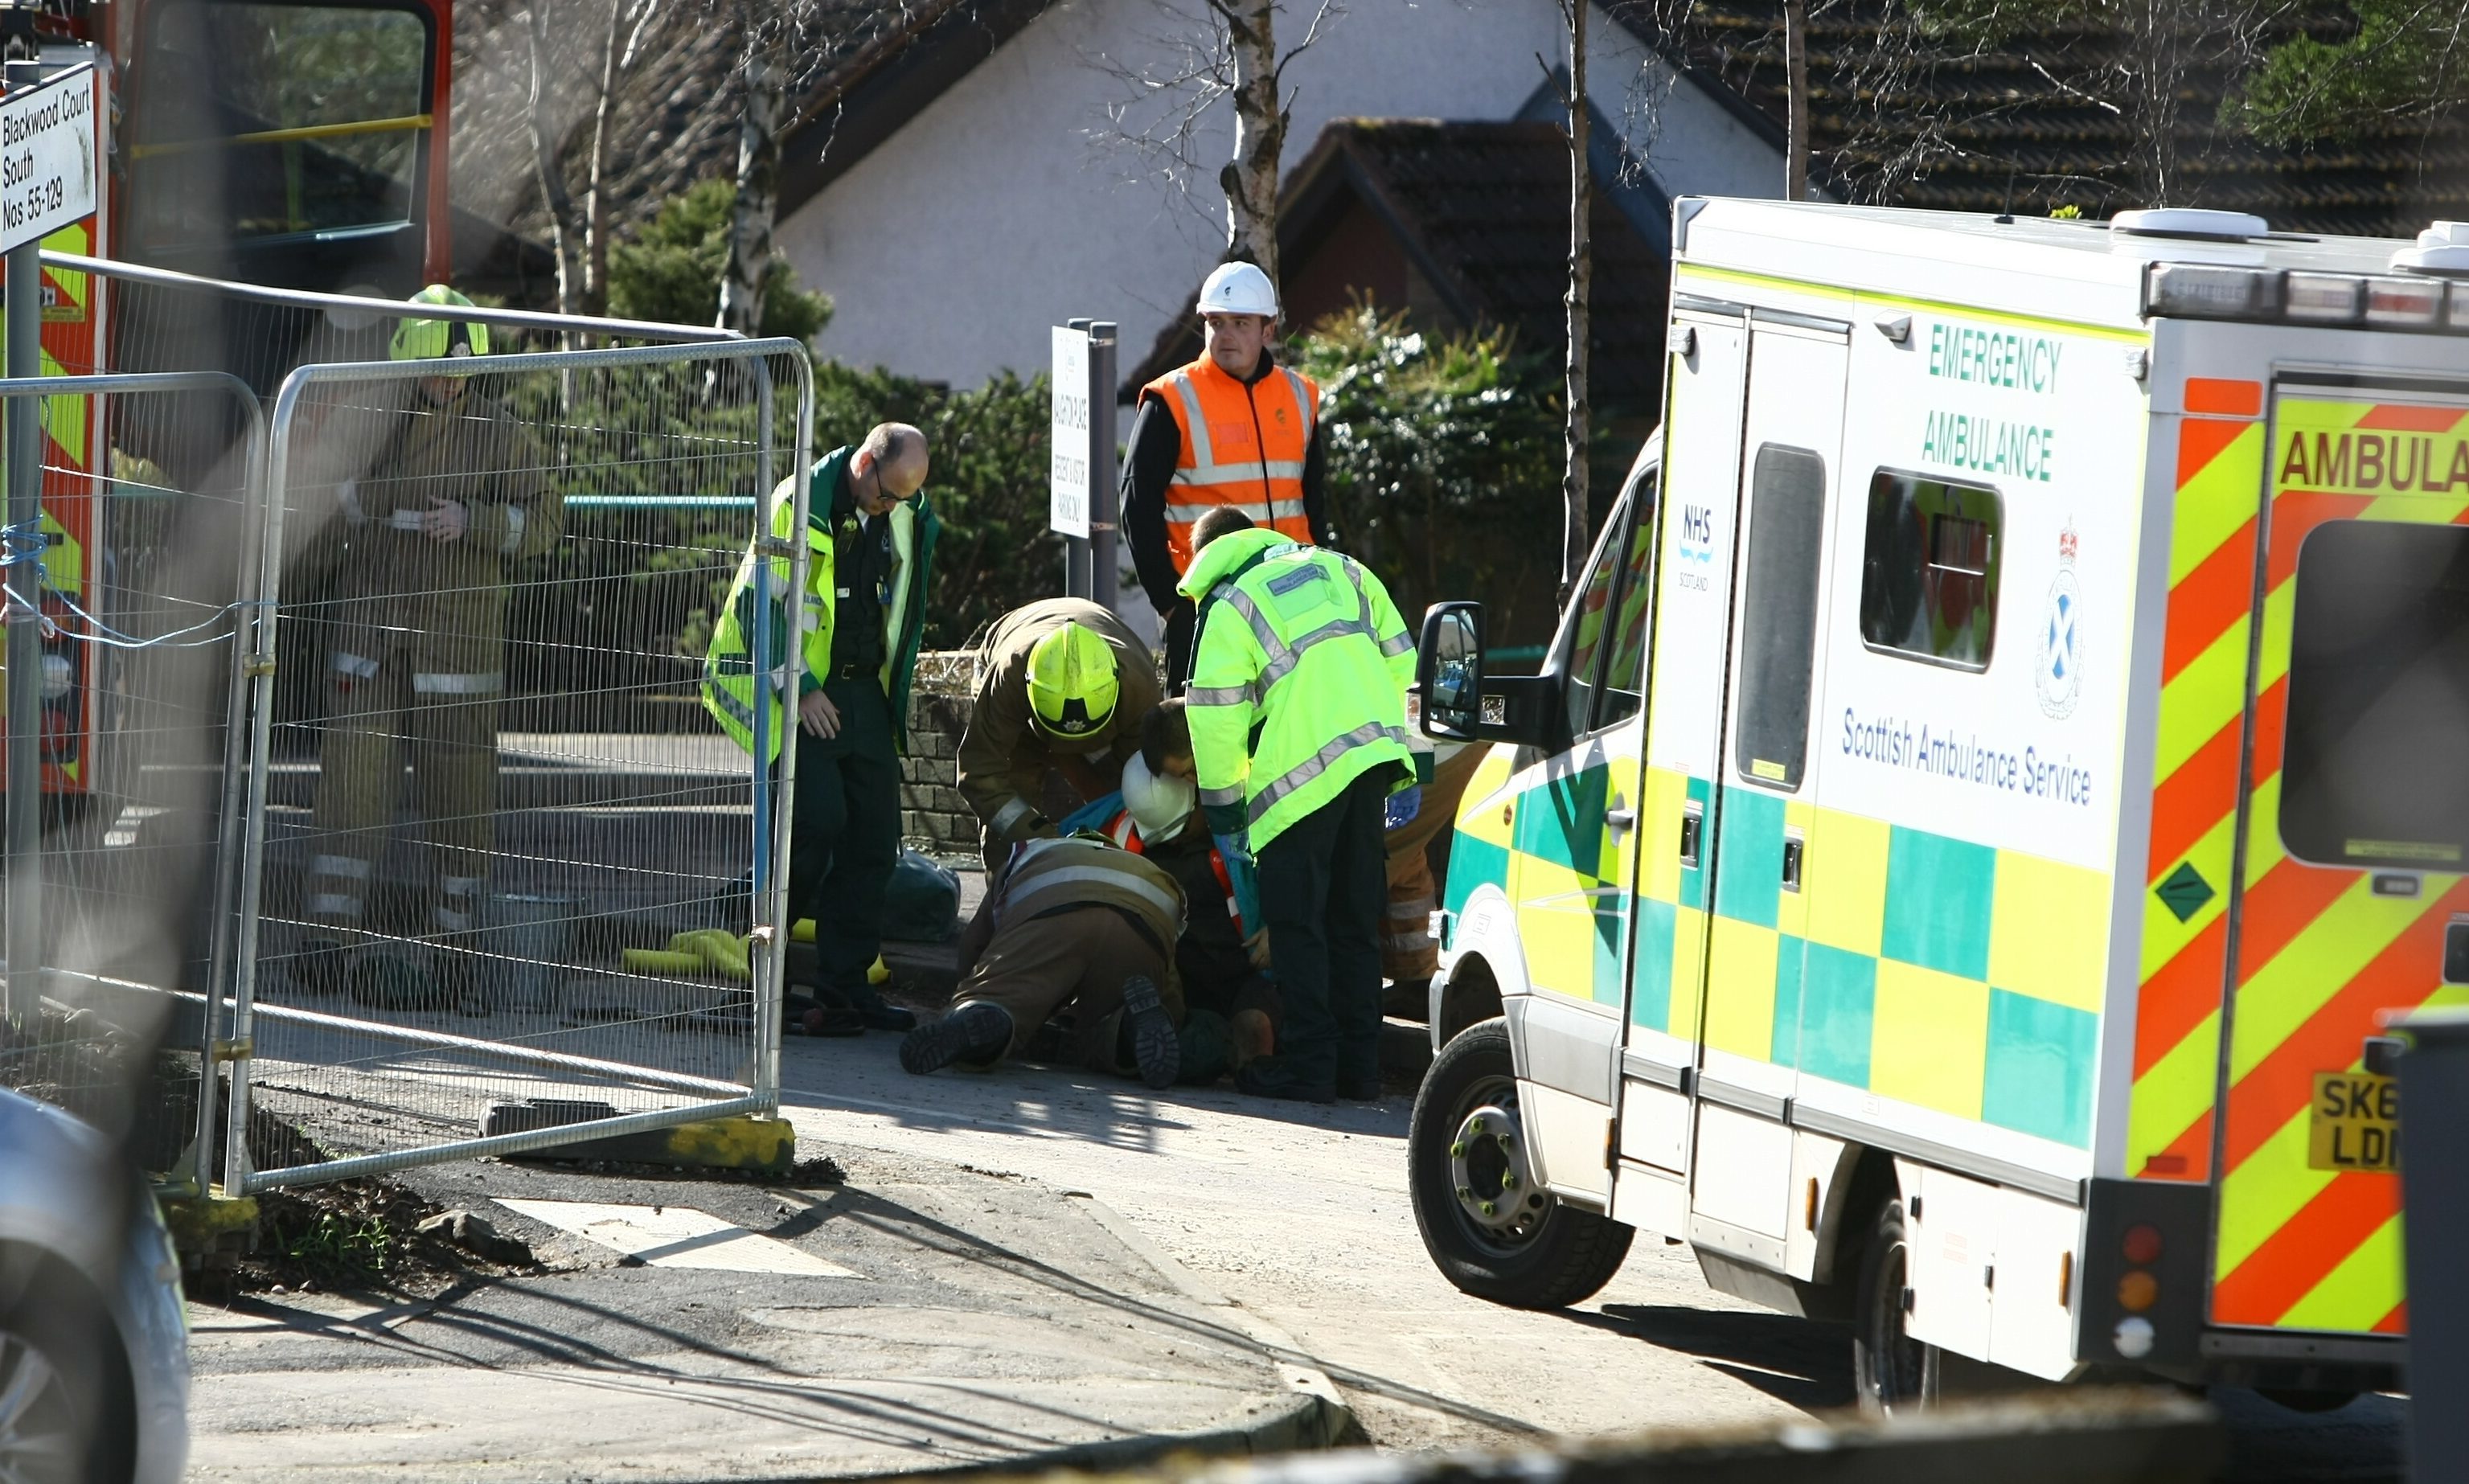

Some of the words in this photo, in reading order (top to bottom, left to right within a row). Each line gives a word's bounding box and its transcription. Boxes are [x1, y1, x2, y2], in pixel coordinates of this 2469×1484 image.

[3, 95, 59, 147] Blackwood
[62, 83, 90, 121] Court
[3, 148, 33, 188] South
[3, 200, 23, 231] Nos
[27, 175, 63, 220] 55-129
[1930, 324, 2062, 394] EMERGENCY
[1921, 410, 2054, 482] AMBULANCE
[1684, 503, 1712, 544] NHS
[1679, 572, 1708, 592] SCOTLAND
[1843, 707, 1913, 769] Scottish
[1917, 724, 2017, 790] Ambulance
[2024, 745, 2090, 806] Service
